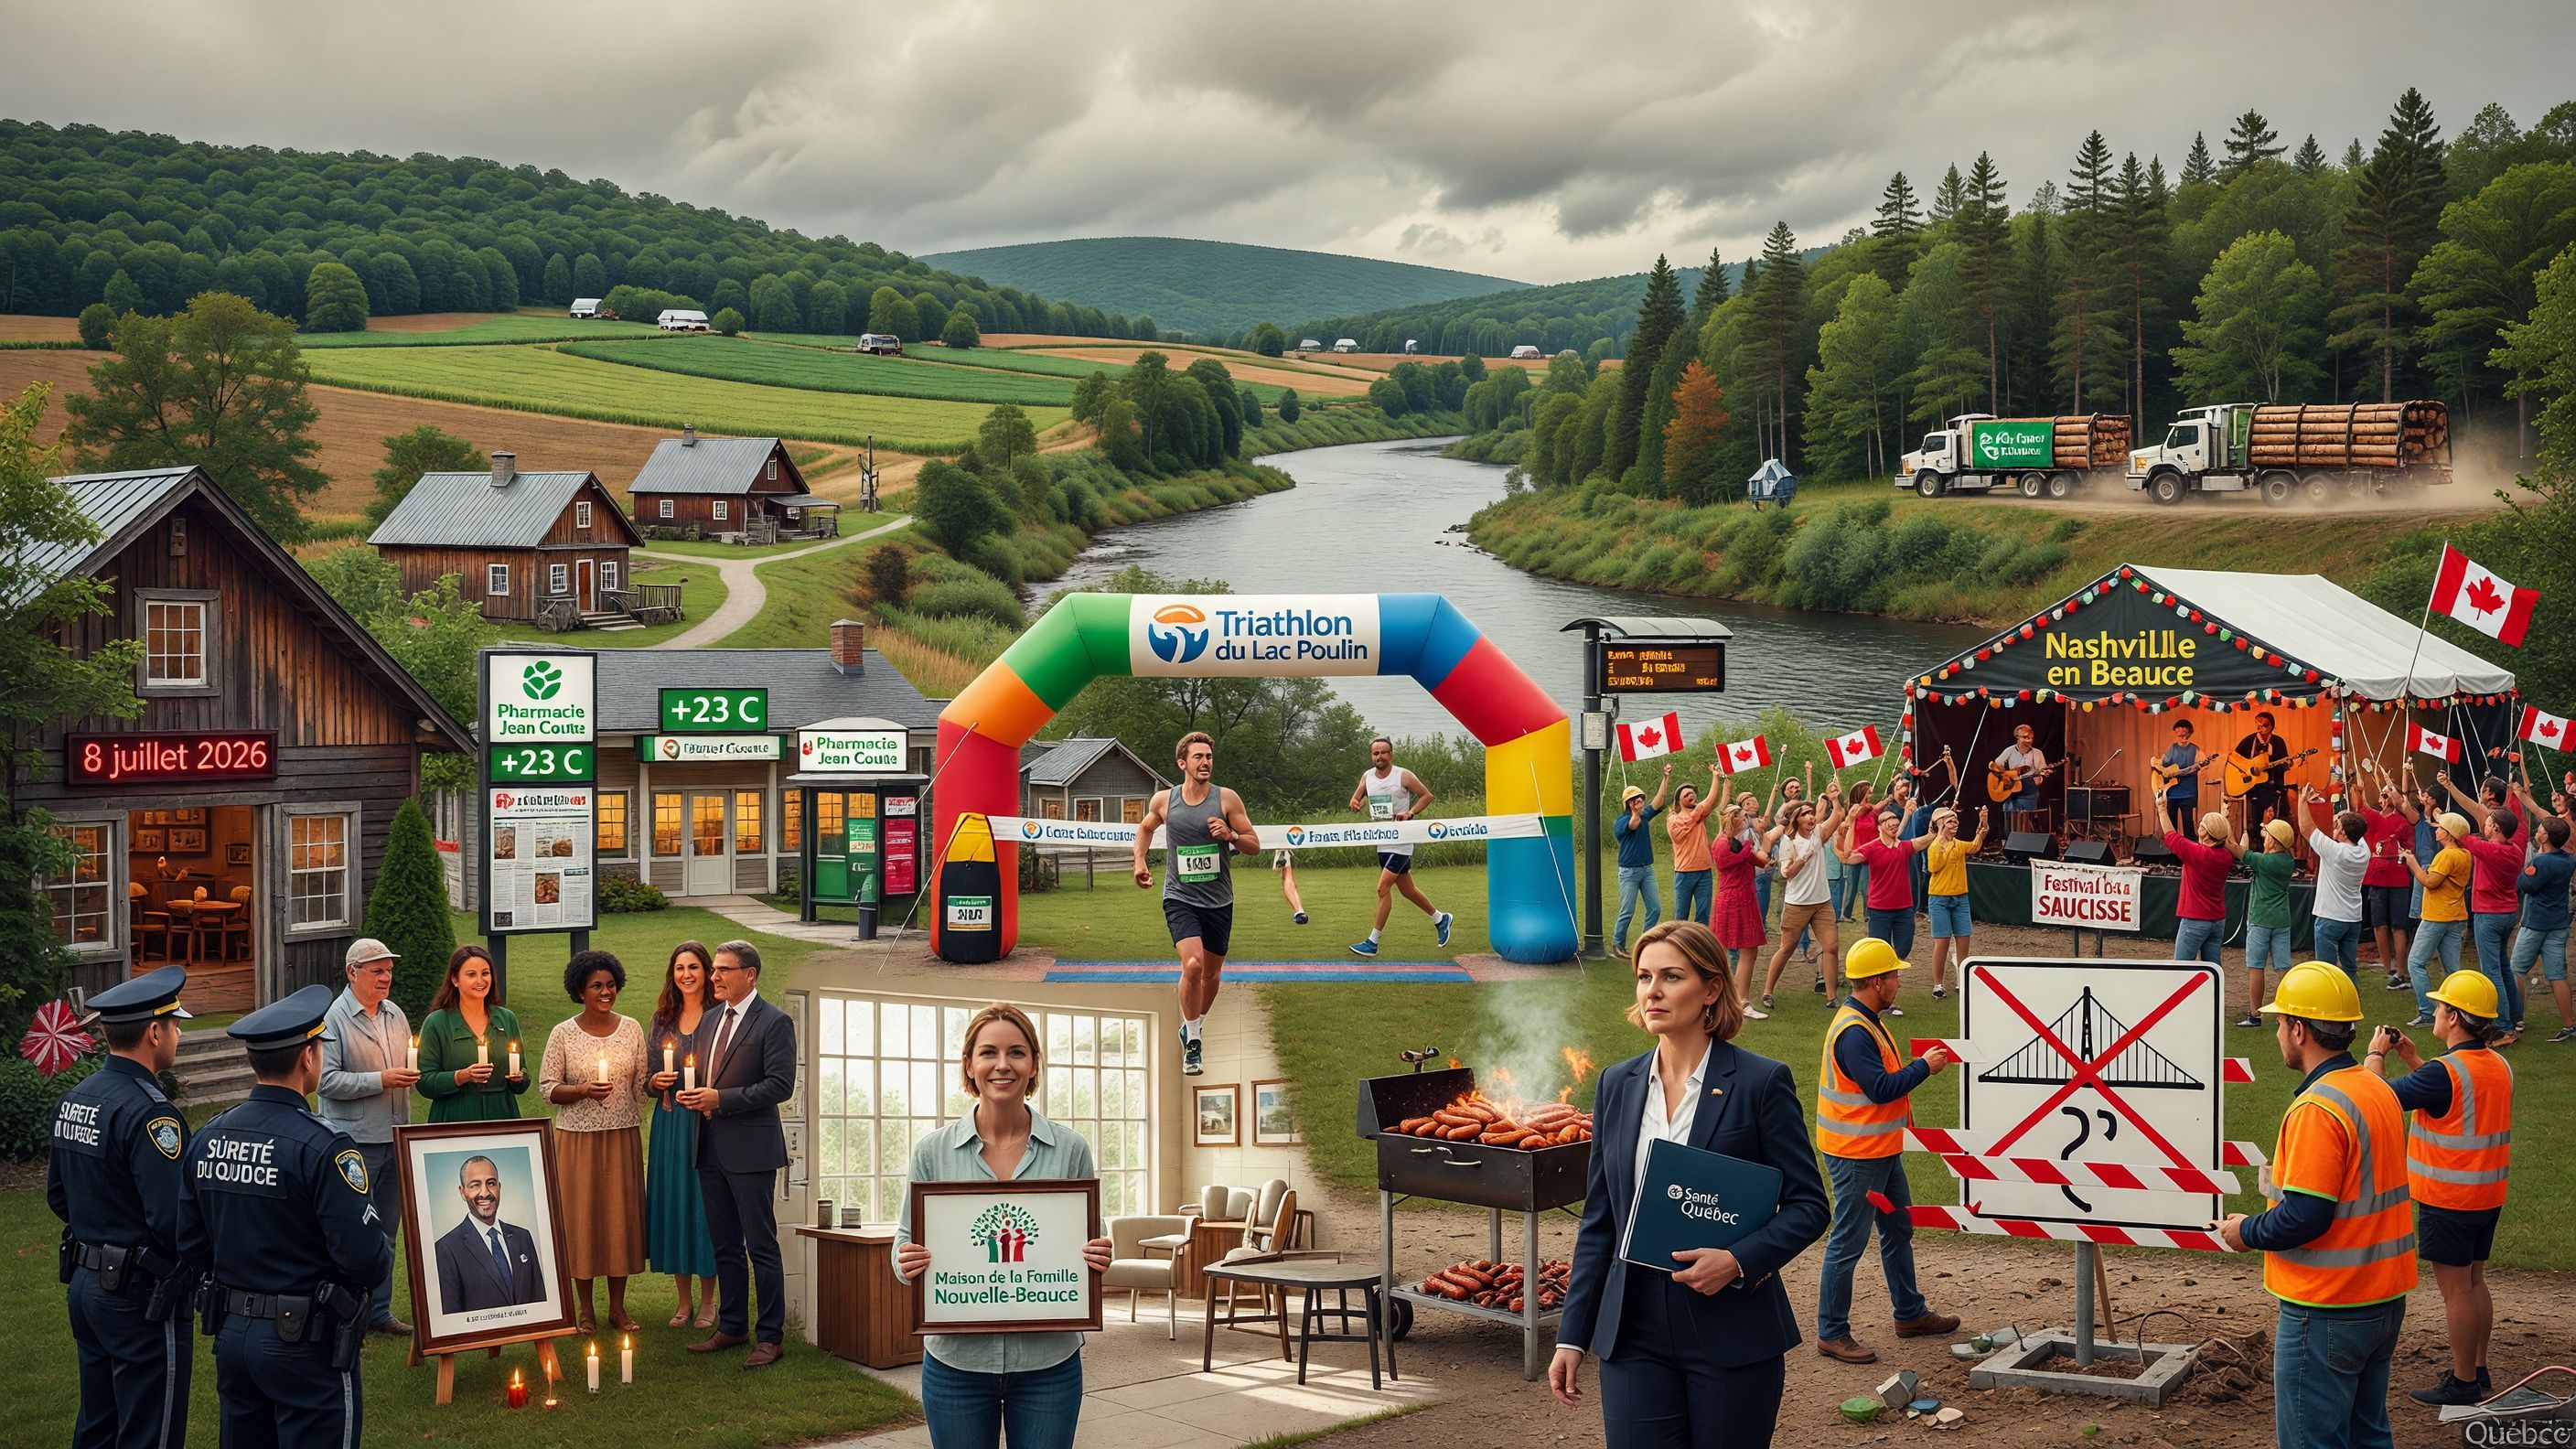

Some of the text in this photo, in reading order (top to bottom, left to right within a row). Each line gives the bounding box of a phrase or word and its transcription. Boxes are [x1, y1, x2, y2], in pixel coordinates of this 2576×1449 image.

[1215, 609, 1352, 637] Triathlon
[1215, 639, 1368, 660] du Lac Poulin
[2047, 660, 2194, 686] en Beauce
[498, 703, 585, 719] Pharmacie
[671, 696, 759, 724] +23 C
[499, 720, 535, 735] Jean
[817, 736, 897, 749] Pharmacie
[83, 740, 267, 779] 8 juillet 2026
[501, 749, 583, 775] +23 C
[818, 752, 850, 765] Jean
[2045, 874, 2100, 895] Festival
[2038, 895, 2131, 922] SAUCISSE
[1685, 1187, 1719, 1206] Santé
[1681, 1200, 1740, 1226] Québec
[935, 1269, 1079, 1284] Maison de la Famille
[935, 1286, 1079, 1304] Nouvelle-Beauce
